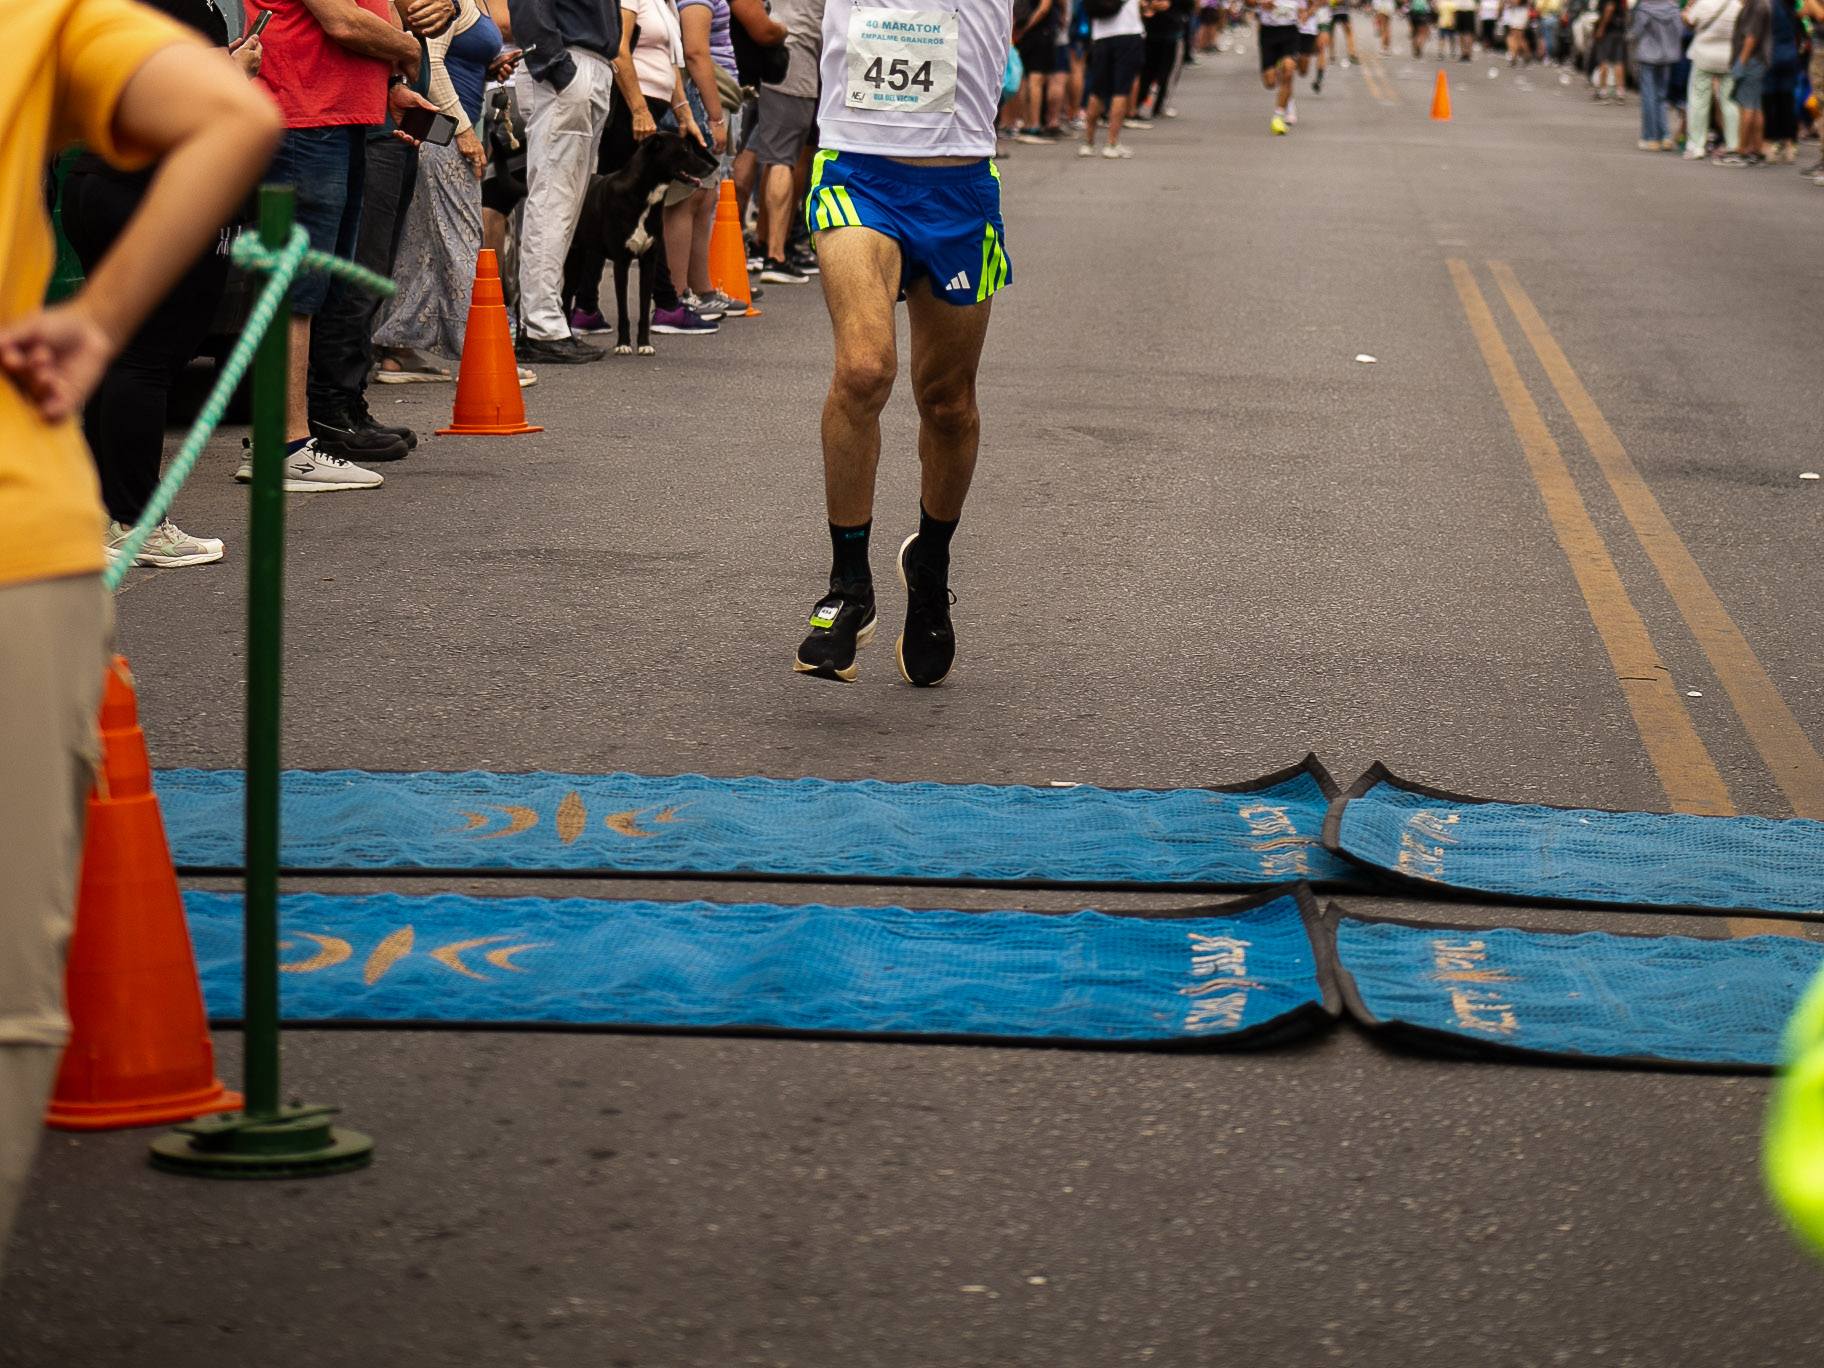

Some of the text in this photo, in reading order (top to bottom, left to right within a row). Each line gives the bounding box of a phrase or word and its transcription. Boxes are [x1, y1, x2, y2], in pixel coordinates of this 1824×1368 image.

[866, 20, 941, 33] 40 MARATON
[861, 32, 944, 45] EMPALME GRANEROS
[864, 56, 934, 93] 454
[873, 93, 919, 103] DIA DEL VECINO
